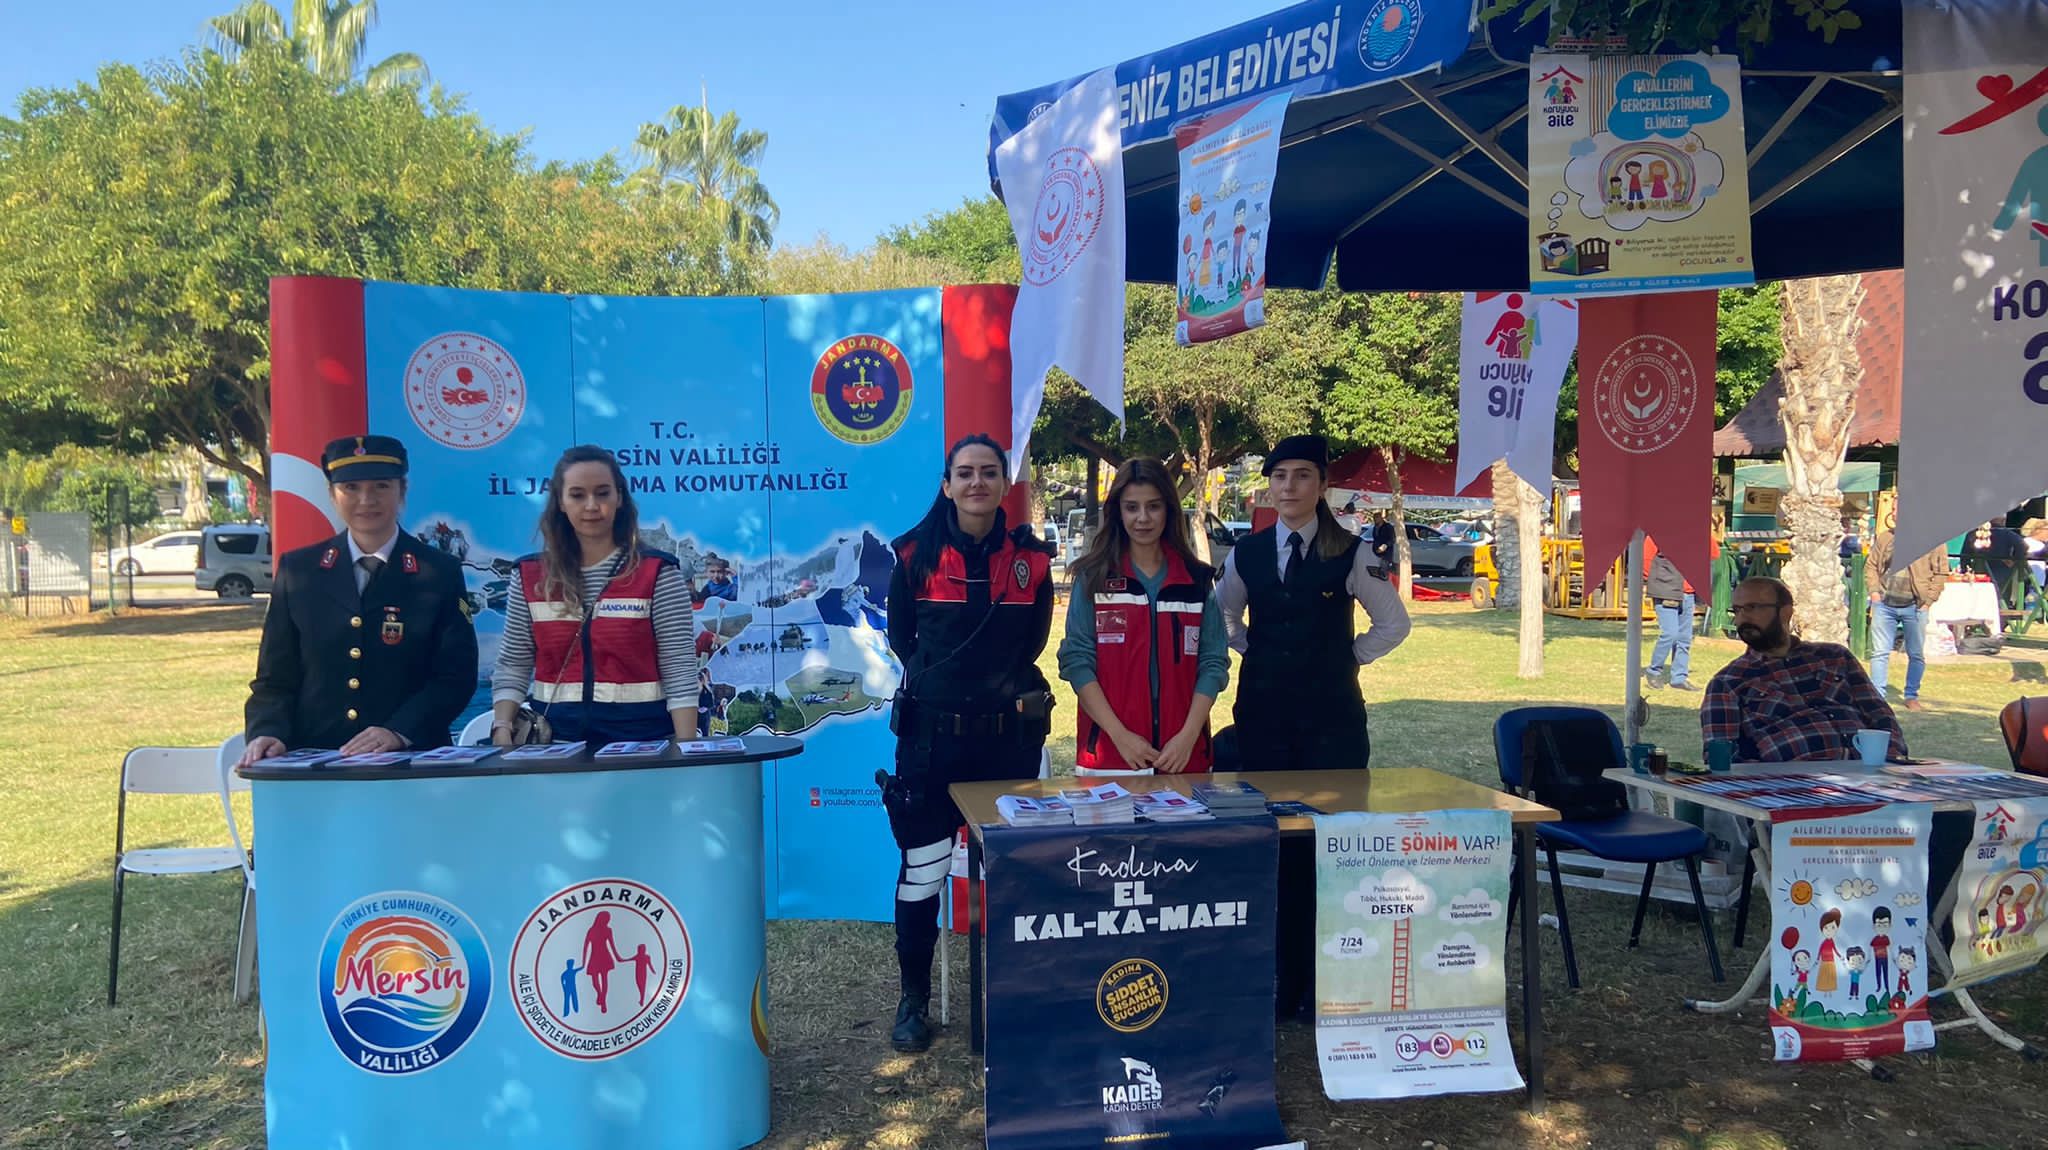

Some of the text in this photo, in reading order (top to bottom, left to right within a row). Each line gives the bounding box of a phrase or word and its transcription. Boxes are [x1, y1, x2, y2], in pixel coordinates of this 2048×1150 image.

[1117, 5, 1341, 128] ENİZ BELEDİYESİ
[1633, 74, 1694, 93] HAYALLERİNİ
[1548, 114, 1575, 127] aile
[1644, 113, 1690, 130] ELİMİZDE
[1679, 257, 1728, 266] ÇOCUKLAR
[821, 337, 899, 370] JANDARMA
[650, 421, 695, 440] T.C.
[670, 442, 781, 466] VALİLİĞİ
[488, 473, 517, 496] İL
[675, 467, 849, 493] KOMUTANLIĞI
[600, 603, 644, 612] JANDARMA
[1327, 832, 1501, 856] BU İLDE ŞÖNİM VAR!
[1067, 845, 1199, 887] Kadına
[1336, 856, 1366, 870] Şiddet
[1368, 855, 1406, 868] Önleme
[1408, 857, 1418, 866] ve
[1453, 854, 1491, 865] Merkezi
[1114, 880, 1153, 907] EL
[342, 899, 460, 930] TÜRKİYE CUMHURİYETİ
[538, 887, 665, 933] JANDARMA
[1371, 903, 1414, 915] DESTEK
[1014, 901, 1248, 942] KAL-KA-MAZ!
[1340, 936, 1363, 947] 7/24
[1106, 963, 1142, 986] KADINA
[519, 973, 533, 994] AİLE
[560, 1034, 611, 1052] MÜCADELE
[611, 1033, 625, 1047] VE
[625, 1014, 656, 1042] ÇOCUK
[653, 995, 673, 1020] KISIM
[1398, 1042, 1418, 1053] 183
[1467, 1039, 1486, 1049] 112
[359, 1044, 440, 1072] VALİLİĞİ
[1102, 1083, 1162, 1105] KADES
[1103, 1100, 1162, 1114] KADIN DESTEK
